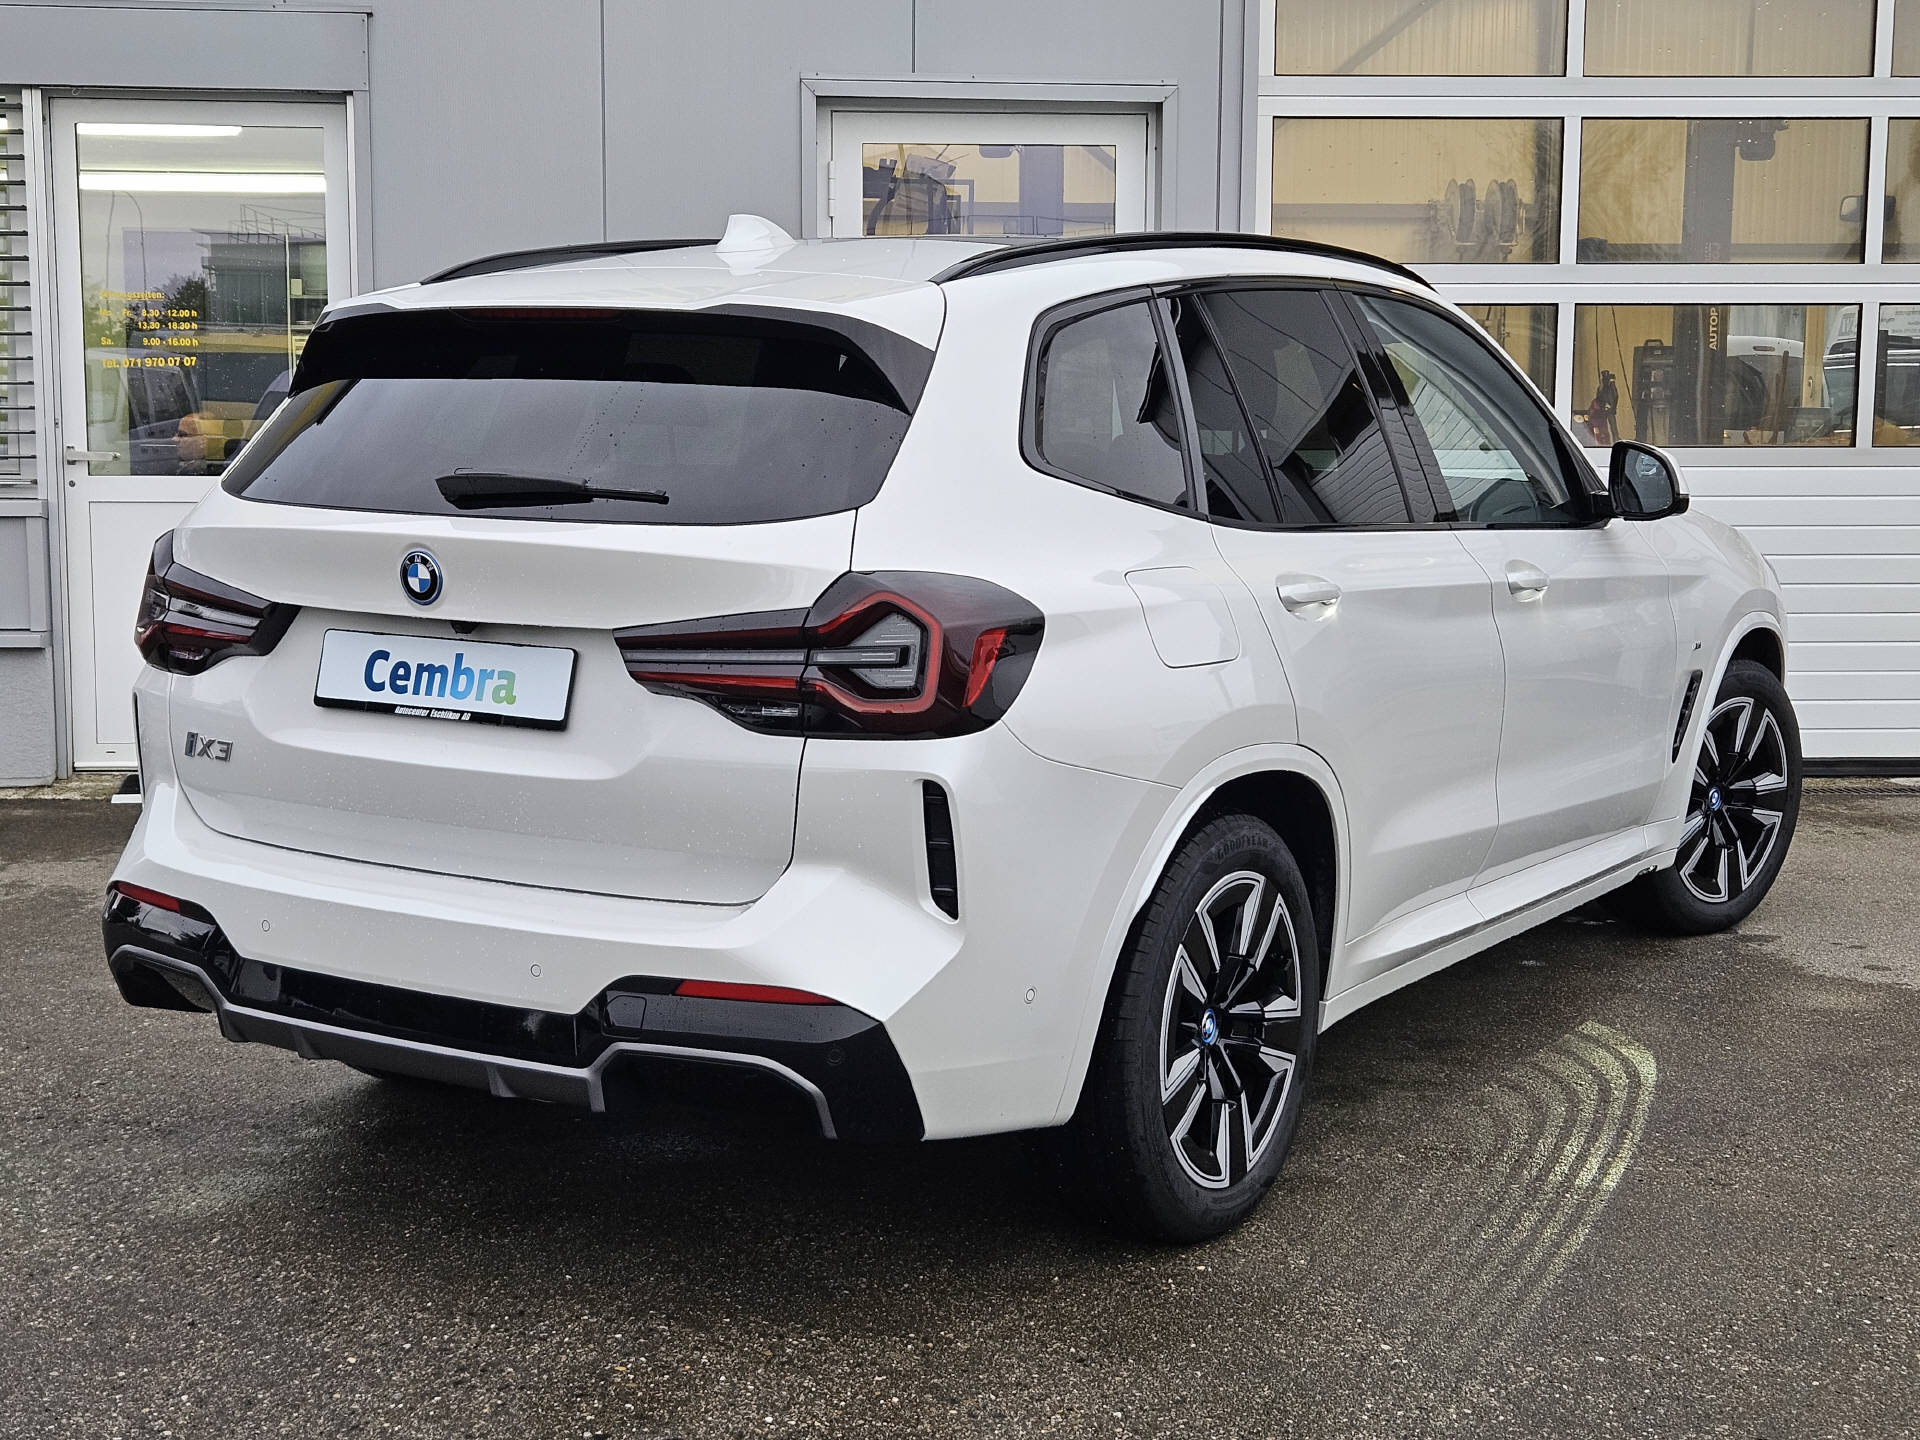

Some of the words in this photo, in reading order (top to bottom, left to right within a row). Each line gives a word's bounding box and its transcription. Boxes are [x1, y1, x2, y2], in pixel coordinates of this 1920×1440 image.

[98, 290, 165, 301] gszeiten:
[141, 309, 160, 317] 8.30
[167, 309, 190, 317] 12.00
[191, 309, 198, 317] h
[138, 321, 160, 329] 13.30
[167, 321, 191, 330] 18.30
[191, 321, 198, 330] h
[1709, 307, 1719, 351] AUTOP
[101, 336, 115, 345] Sa.
[143, 337, 161, 346] 9.00
[167, 337, 191, 346] 16.00
[192, 337, 199, 346] h
[122, 357, 142, 368] 071
[144, 357, 166, 367] 970
[167, 357, 181, 367] 07
[183, 356, 197, 366] 07
[364, 649, 517, 706] Cembra
